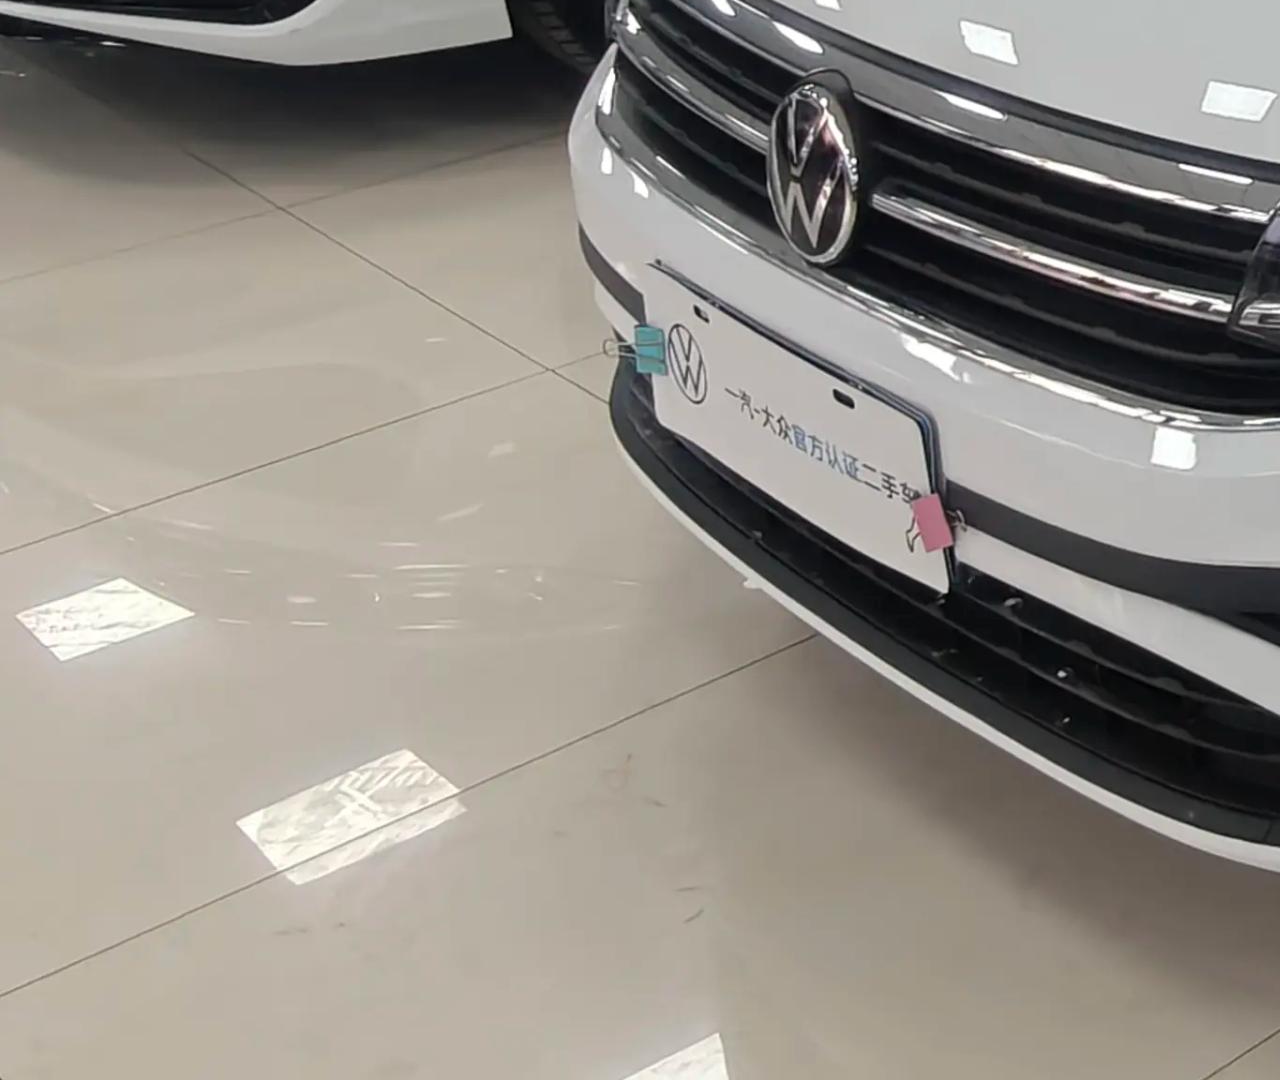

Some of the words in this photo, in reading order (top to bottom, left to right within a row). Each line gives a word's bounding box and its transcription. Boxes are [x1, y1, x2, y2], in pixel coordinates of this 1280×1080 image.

[724, 385, 921, 504] 一汽-大众官方认证二手车
